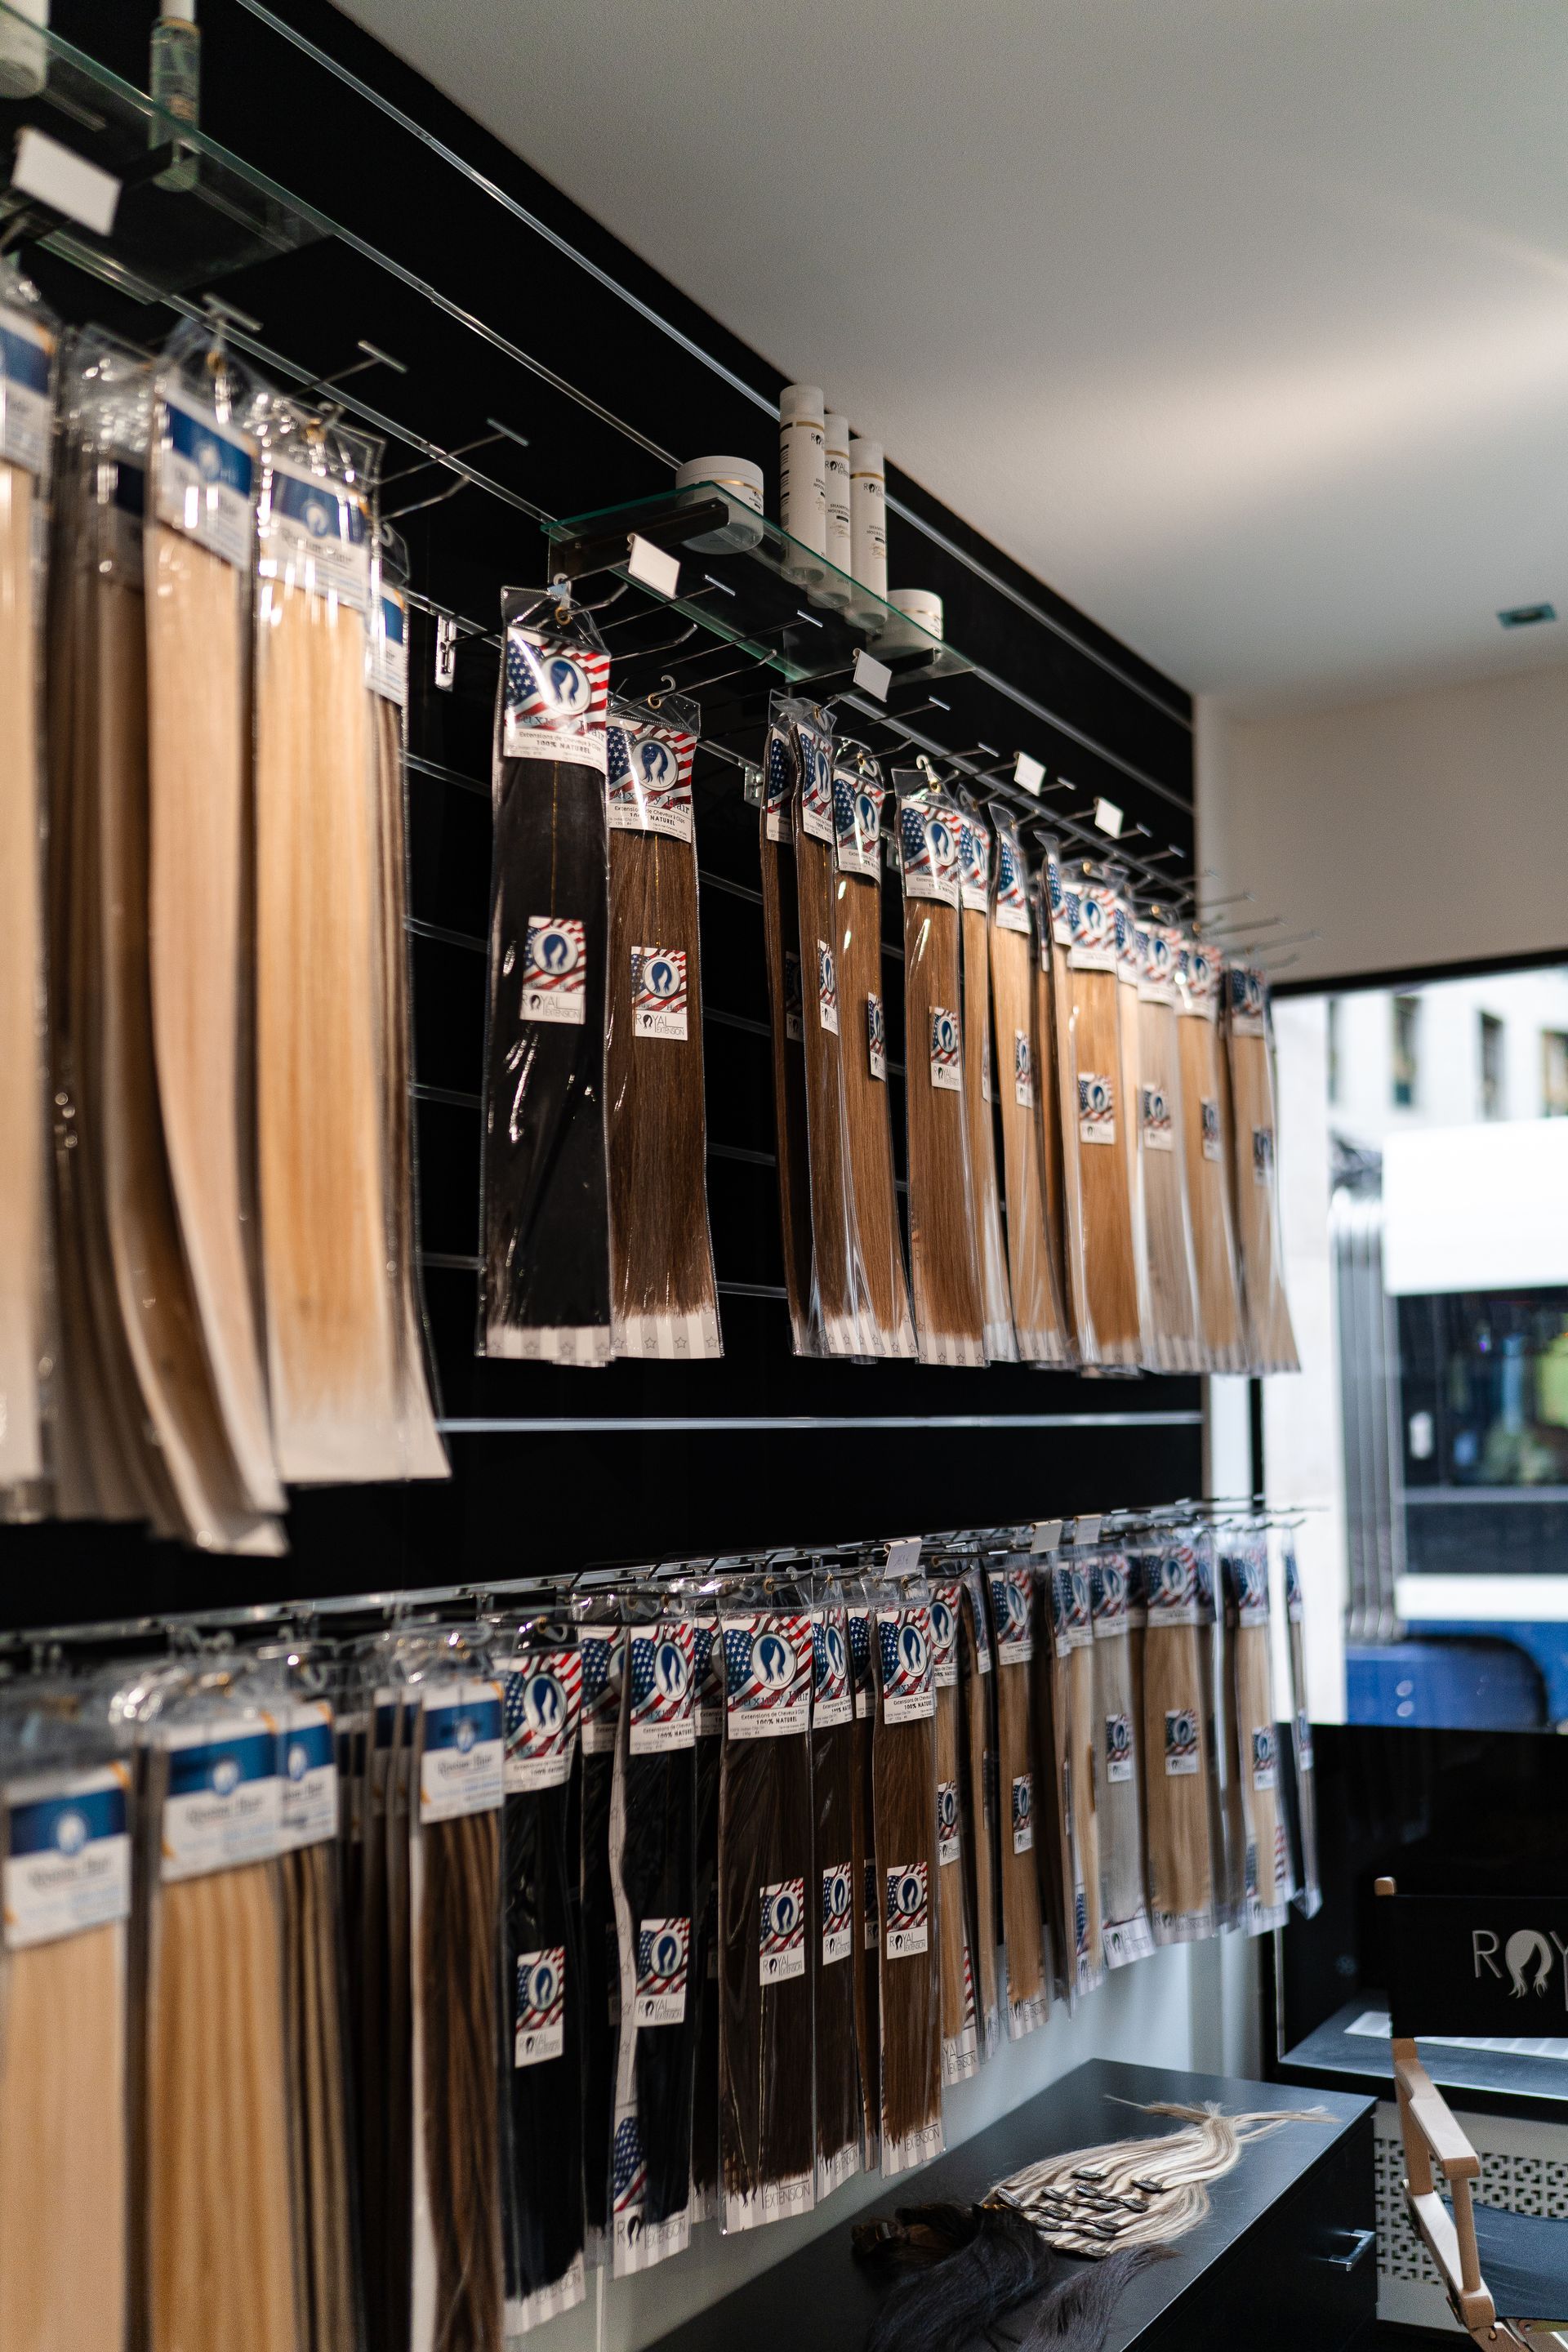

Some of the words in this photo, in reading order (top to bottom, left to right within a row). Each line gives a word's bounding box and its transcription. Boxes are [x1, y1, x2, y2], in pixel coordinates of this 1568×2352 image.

[519, 732, 554, 741] Extensions
[537, 740, 557, 748] 100%
[559, 743, 591, 755] NATUREL
[613, 791, 662, 805] Luxry
[666, 795, 690, 815] Hair
[650, 815, 675, 826] NATUREL
[653, 811, 673, 820] Cheveux
[523, 994, 581, 1015] ROYAL
[635, 1014, 684, 1032] ROYAL
[657, 1027, 684, 1036] EXTENSION
[886, 1682, 923, 1694] Luxury
[731, 1695, 785, 1708] Luxury
[788, 1690, 808, 1703] Hair
[893, 1698, 914, 1706] Extensions
[741, 1712, 770, 1720] Extensions
[777, 1709, 795, 1717] Cheveux
[776, 1716, 797, 1724] NATUREL
[657, 1731, 672, 1739] 100%
[825, 1936, 850, 1955] ROYAL
[889, 1932, 925, 1952] ROYAL
[905, 1942, 926, 1952] EXTENSION
[763, 1955, 803, 1976] ROYAL
[638, 1998, 682, 2020] ROYAL
[949, 2053, 976, 2074] EXTENSION
[906, 2126, 940, 2151] EXTENSION
[764, 2184, 810, 2210] EXTENSION
